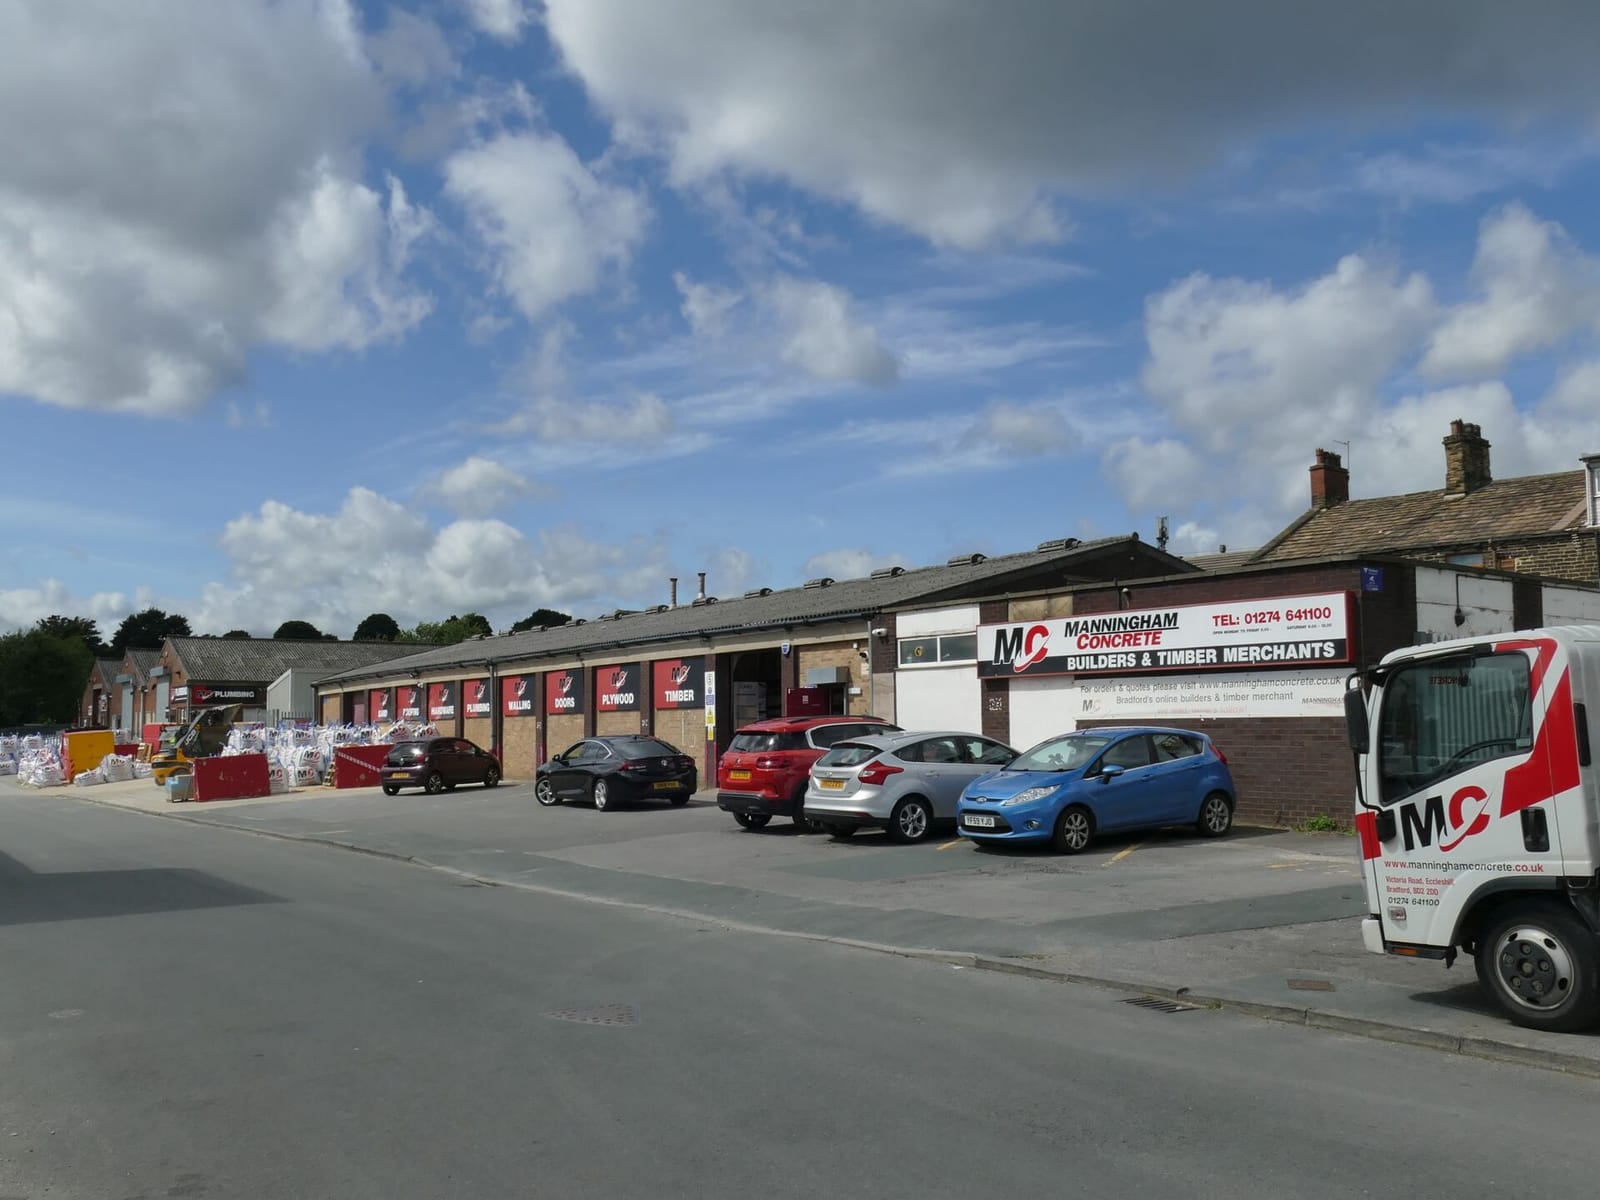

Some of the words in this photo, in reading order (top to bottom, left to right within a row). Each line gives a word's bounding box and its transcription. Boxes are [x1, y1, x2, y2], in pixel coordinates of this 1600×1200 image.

[1212, 614, 1240, 627] TEL:
[1244, 611, 1281, 625] 01274
[1285, 606, 1332, 622] 641100
[1064, 612, 1178, 638] MANNINGHAM
[1076, 631, 1163, 650] CONCRETE
[1067, 653, 1137, 671] BUILDERS
[1141, 653, 1152, 667] &
[1157, 648, 1218, 666] TIMBER
[1223, 641, 1336, 664] MERCHANTS
[1080, 685, 1092, 693] For
[1093, 684, 1116, 693] orders
[1126, 683, 1151, 693] quotes
[1152, 682, 1178, 693] please
[1180, 680, 1197, 690] visit
[1199, 676, 1341, 690] www.manninghamconcrete.co.uk
[214, 690, 255, 698] PLUMBING
[602, 693, 635, 705] PLYWOOD
[664, 689, 695, 702] TIMBER
[1116, 695, 1153, 705] Bradford's
[1155, 694, 1178, 704] online
[1180, 693, 1212, 703] builders
[1214, 693, 1220, 702] &
[1223, 692, 1249, 702] timber
[1252, 691, 1294, 702] merchant
[466, 702, 490, 713] PLUMBING
[508, 700, 532, 711] WALLING
[555, 697, 576, 709] DOORS
[1400, 785, 1491, 853] MC
[1384, 859, 1544, 873] www.manninghamconcrete.co.uk
[1386, 875, 1407, 884] Victoria
[1386, 885, 1411, 895] Bradford,
[1387, 896, 1409, 905] 01274
[1411, 897, 1440, 906] 641100
